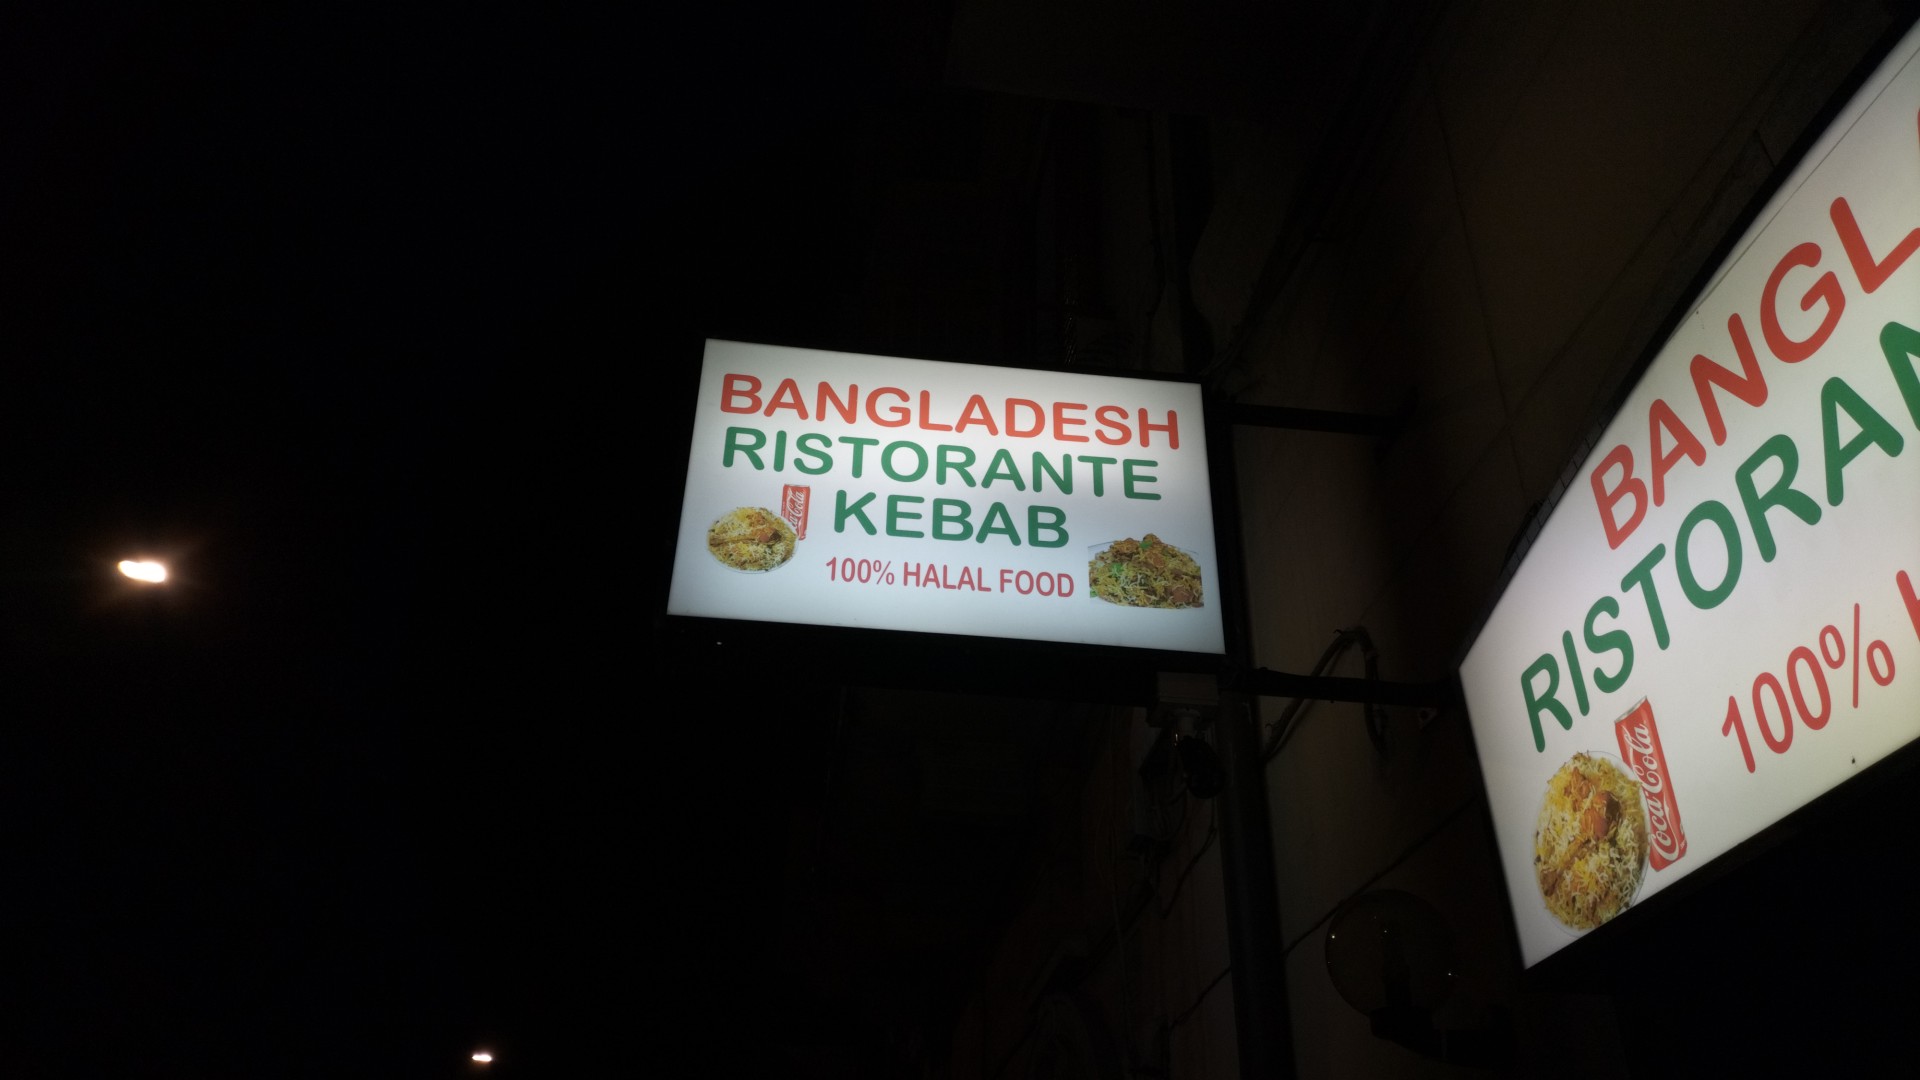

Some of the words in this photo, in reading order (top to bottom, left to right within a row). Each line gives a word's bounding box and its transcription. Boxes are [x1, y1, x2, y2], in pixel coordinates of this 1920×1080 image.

[1589, 107, 1920, 551] BANGL
[719, 373, 1180, 450] BANGLADESH
[722, 426, 1162, 501] RISTORANTE
[833, 489, 1070, 548] KEBAB
[825, 556, 895, 586] 100%
[903, 561, 992, 592] HALAL
[999, 568, 1075, 598] FOOD
[1721, 603, 1896, 774] 100%
